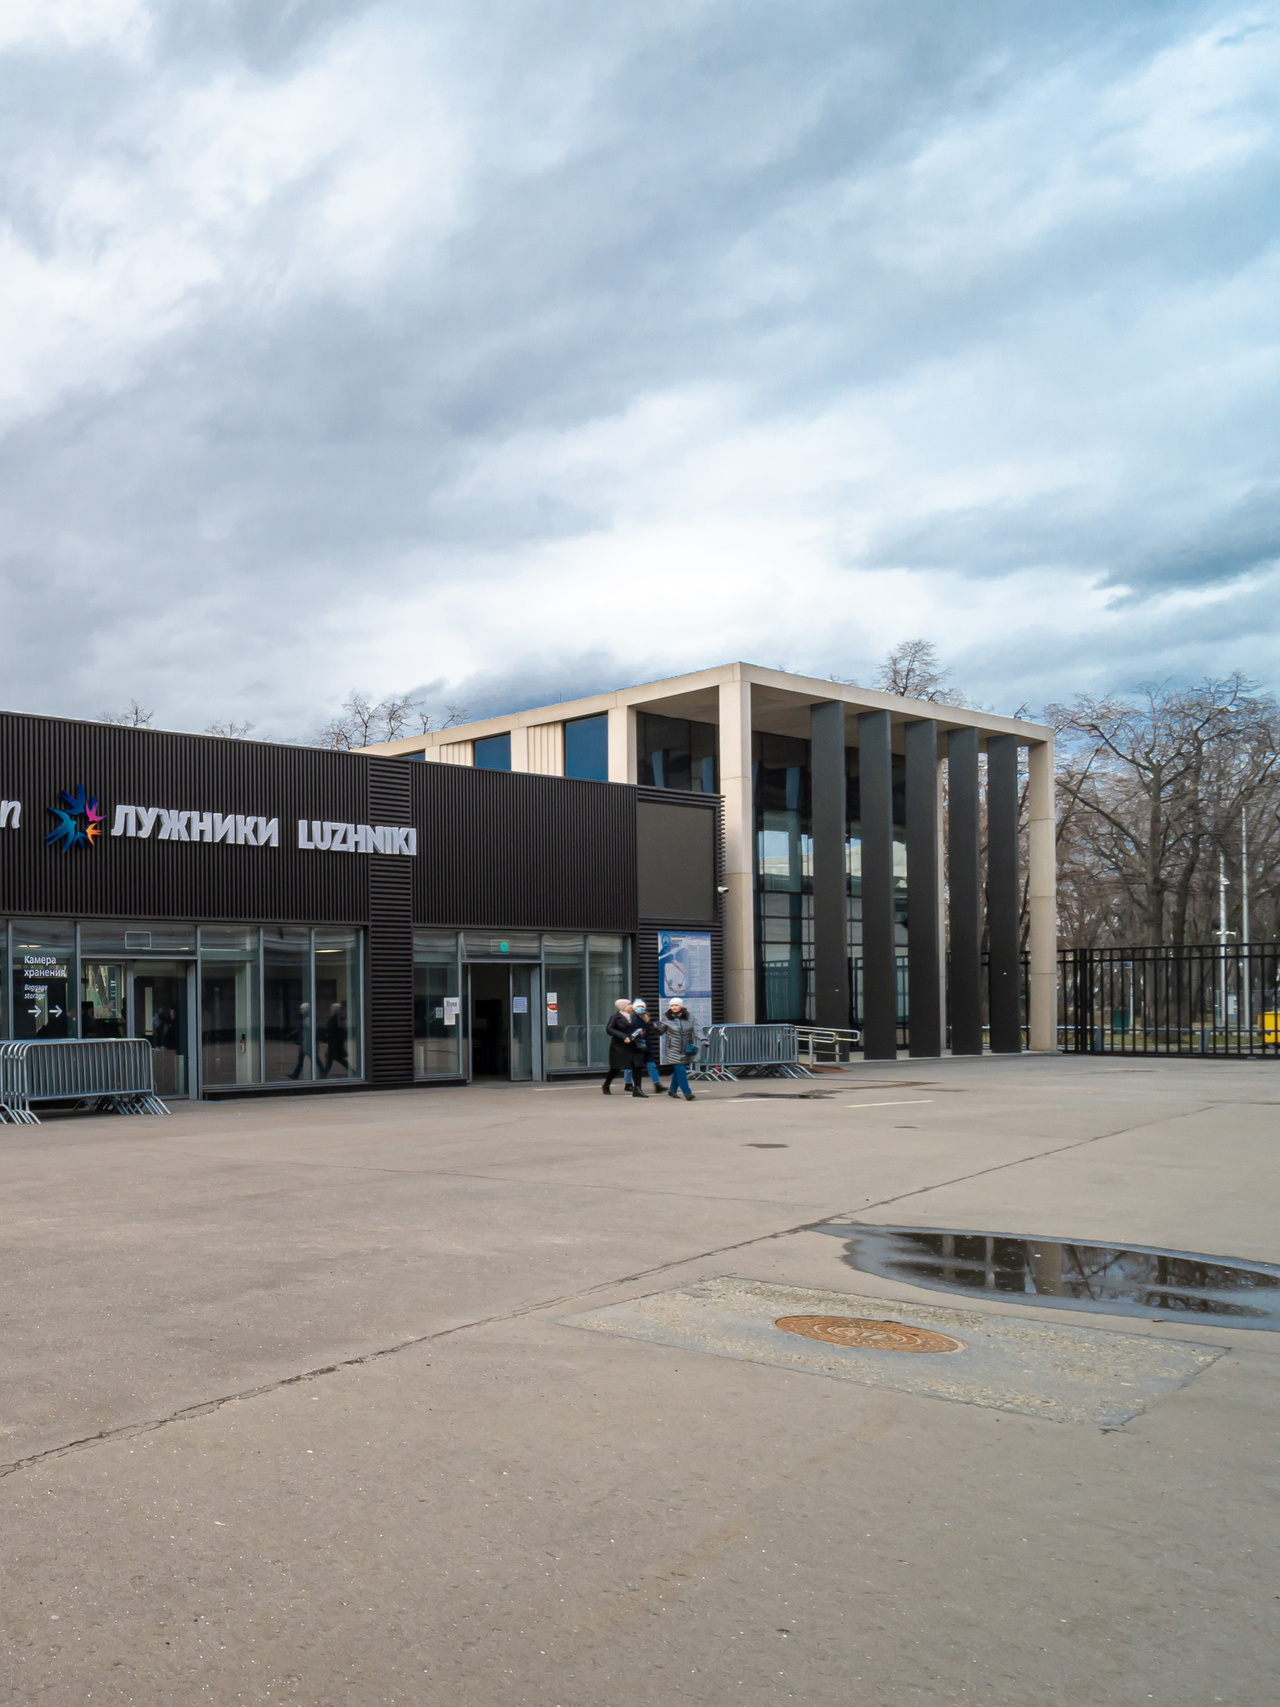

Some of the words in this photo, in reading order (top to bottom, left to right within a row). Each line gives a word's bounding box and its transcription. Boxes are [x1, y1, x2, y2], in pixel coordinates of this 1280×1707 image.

[110, 804, 280, 848] ЛУЖНИКИ
[297, 819, 418, 856] LUZHNIKI
[24, 955, 57, 966] Камера
[23, 968, 67, 979] хранения
